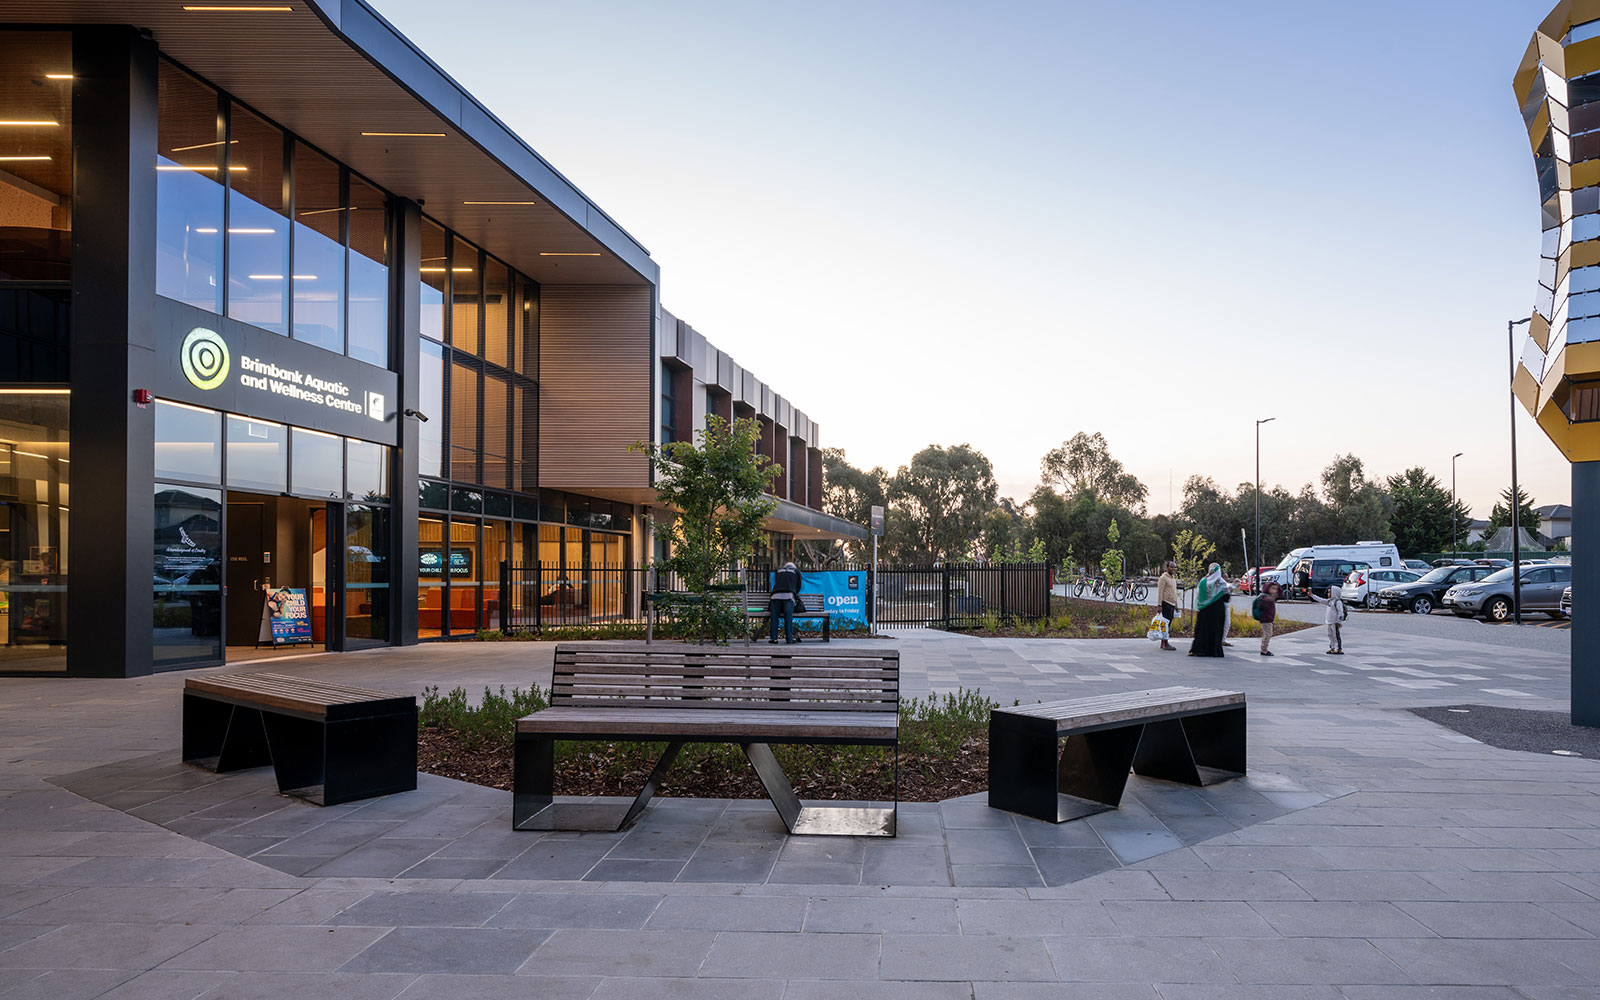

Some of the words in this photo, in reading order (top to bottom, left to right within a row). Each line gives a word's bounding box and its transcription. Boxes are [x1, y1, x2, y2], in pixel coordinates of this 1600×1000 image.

[240, 374, 268, 391] and
[269, 379, 324, 405] Wellness
[325, 394, 363, 414] Centre
[241, 355, 303, 385] Brimbank
[304, 374, 349, 396] Aquatic
[828, 596, 858, 606] open
